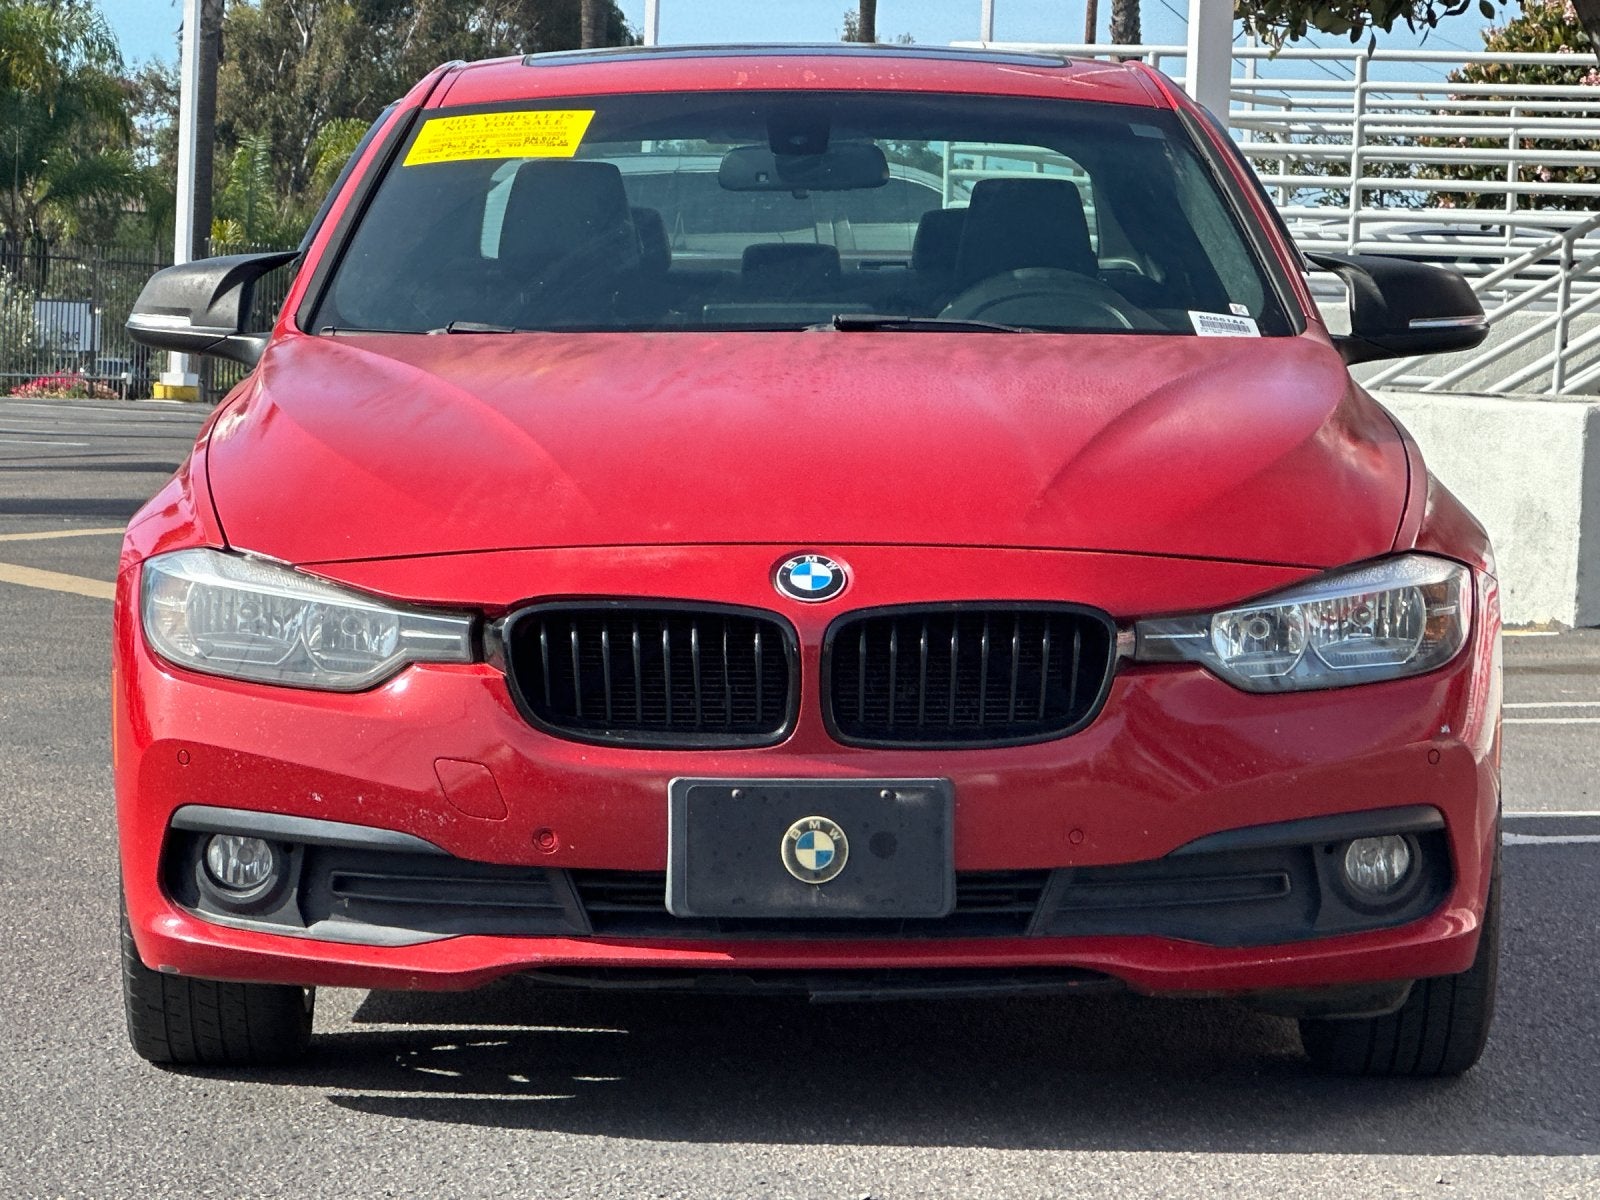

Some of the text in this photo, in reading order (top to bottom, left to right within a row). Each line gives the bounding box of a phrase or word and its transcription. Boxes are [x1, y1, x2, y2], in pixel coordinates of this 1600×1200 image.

[483, 112, 552, 123] VEHICLE
[560, 112, 575, 120] IS
[445, 123, 476, 131] NOT
[484, 120, 516, 128] FOR
[784, 556, 840, 570] BMW
[789, 820, 841, 841] BMW
